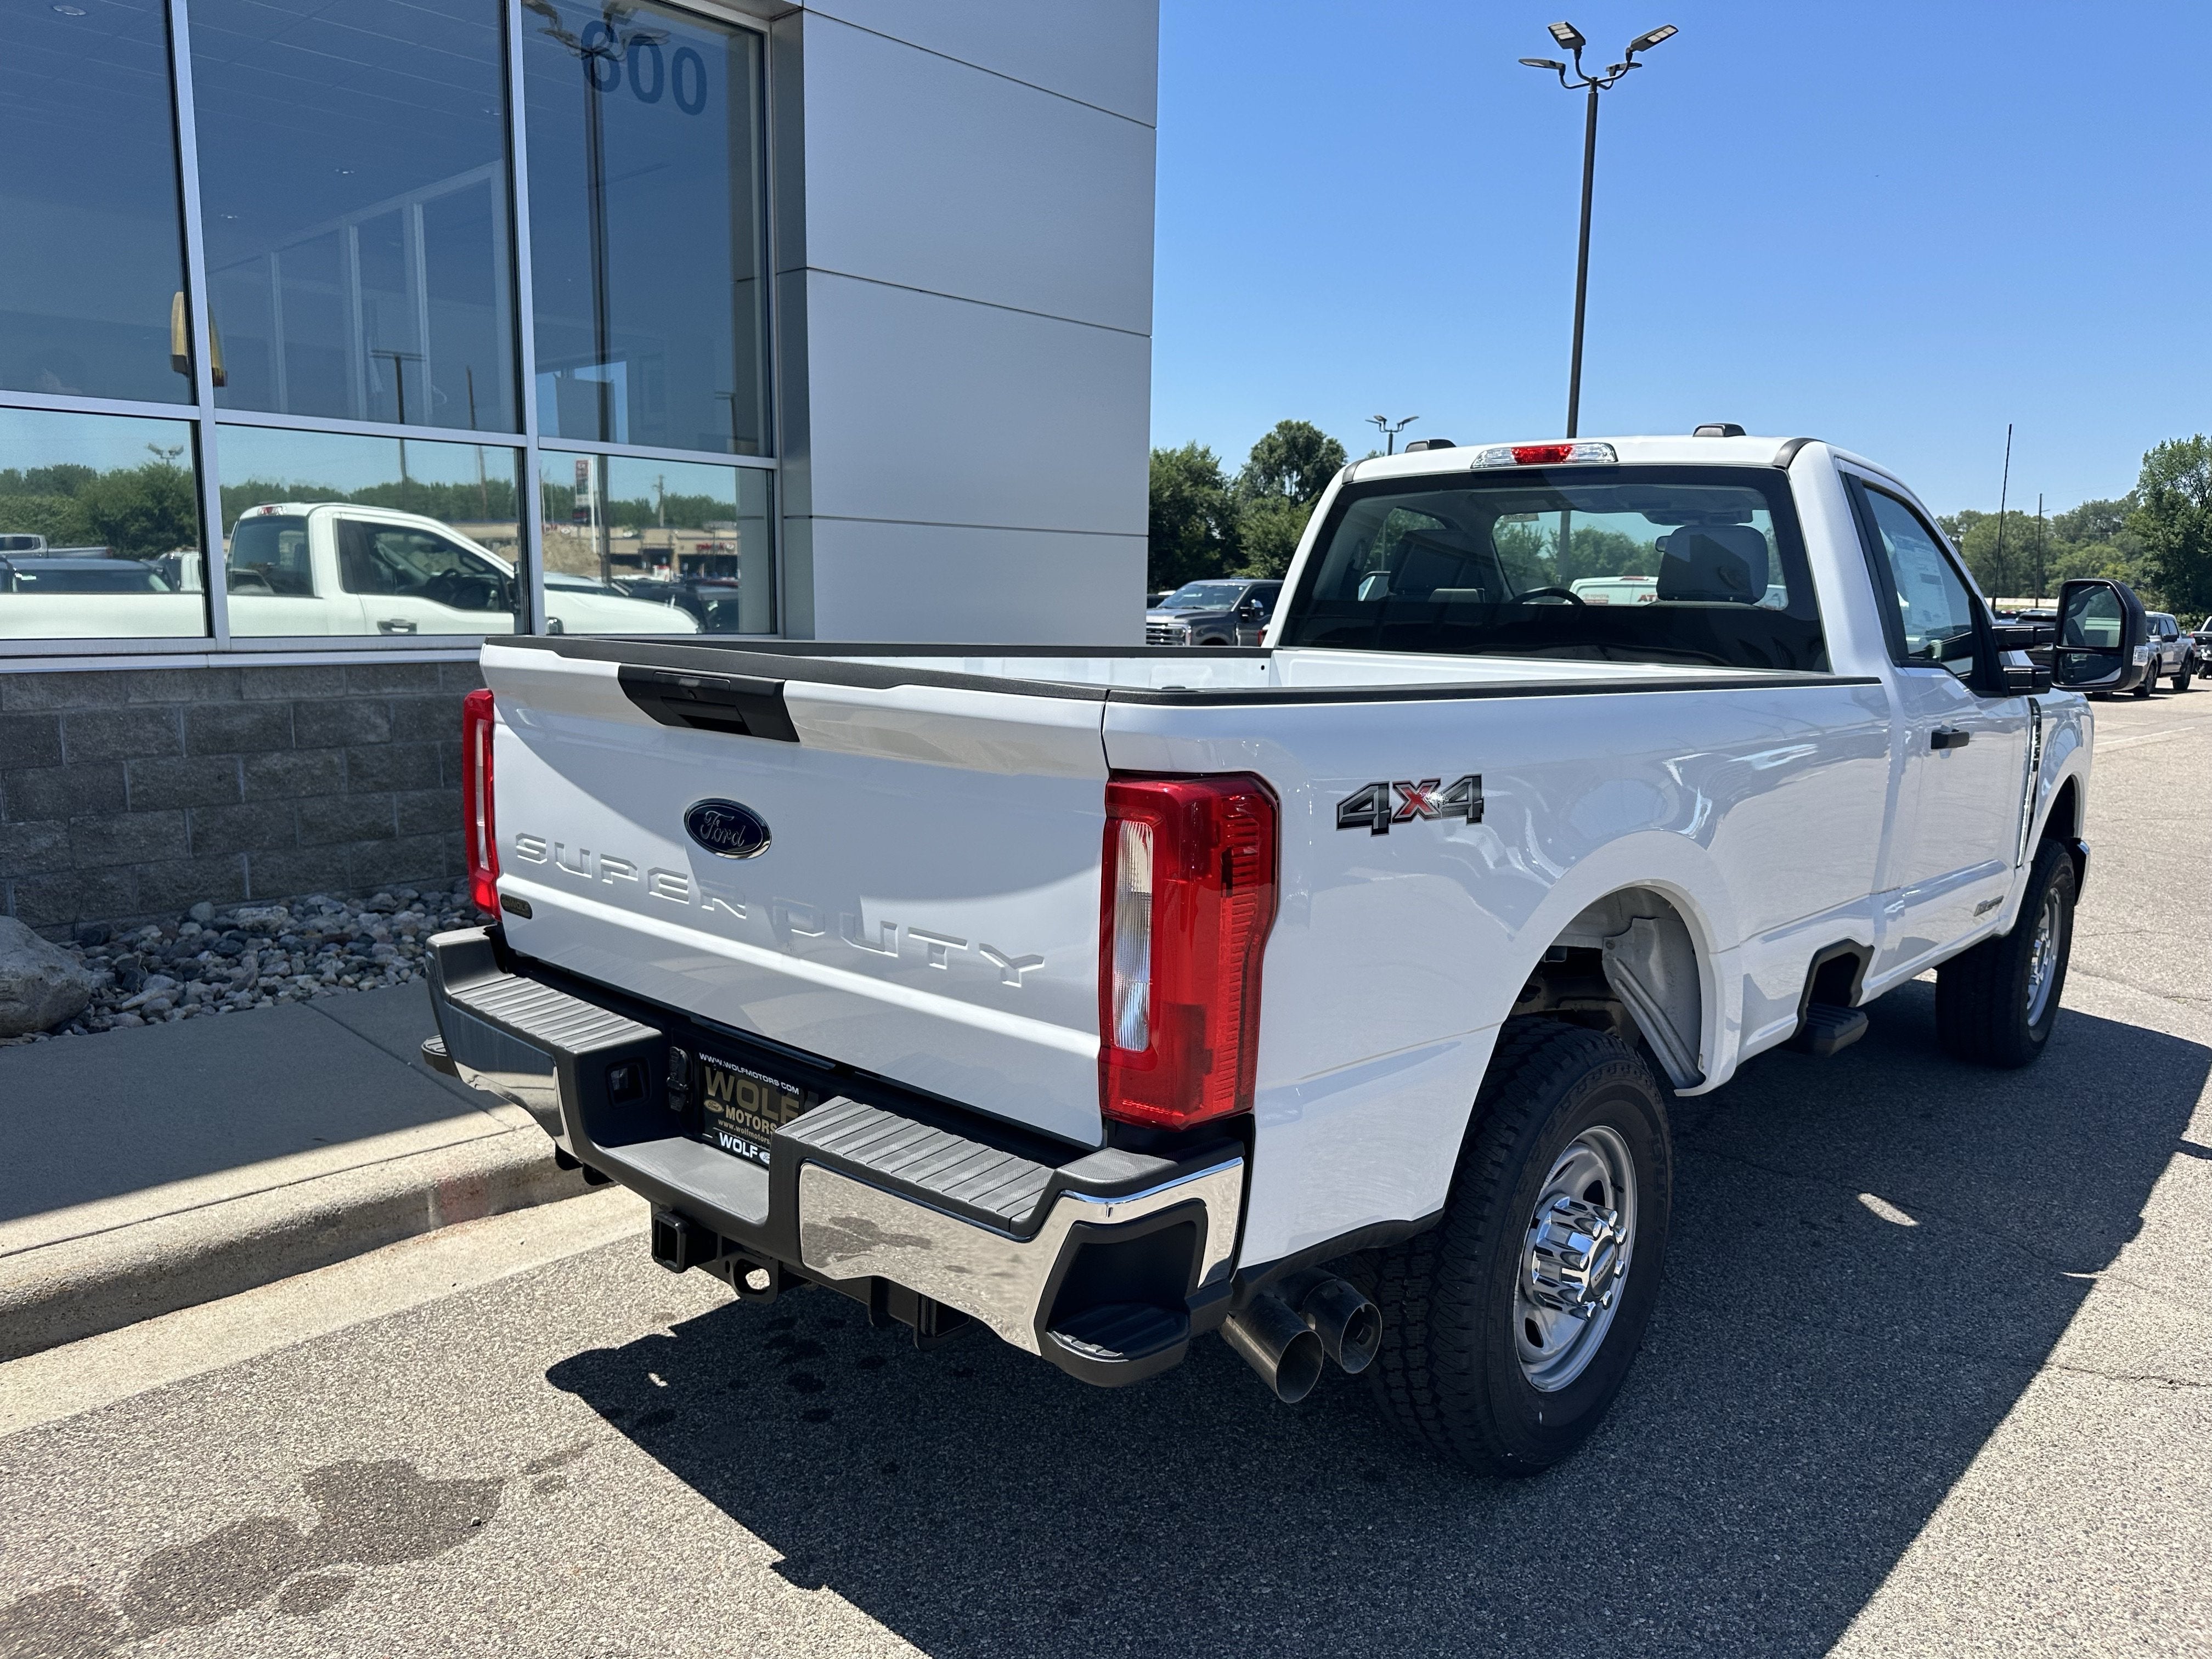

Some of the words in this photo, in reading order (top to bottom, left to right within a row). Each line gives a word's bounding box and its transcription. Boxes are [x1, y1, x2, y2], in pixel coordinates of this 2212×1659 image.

[581, 20, 707, 116] 600
[700, 810, 746, 847] Ford
[515, 832, 747, 919] SUPER
[772, 896, 1045, 988] DUTY
[705, 1066, 799, 1125] WOLF
[726, 1104, 777, 1135] MOTORS
[719, 1132, 758, 1158] WOLF
